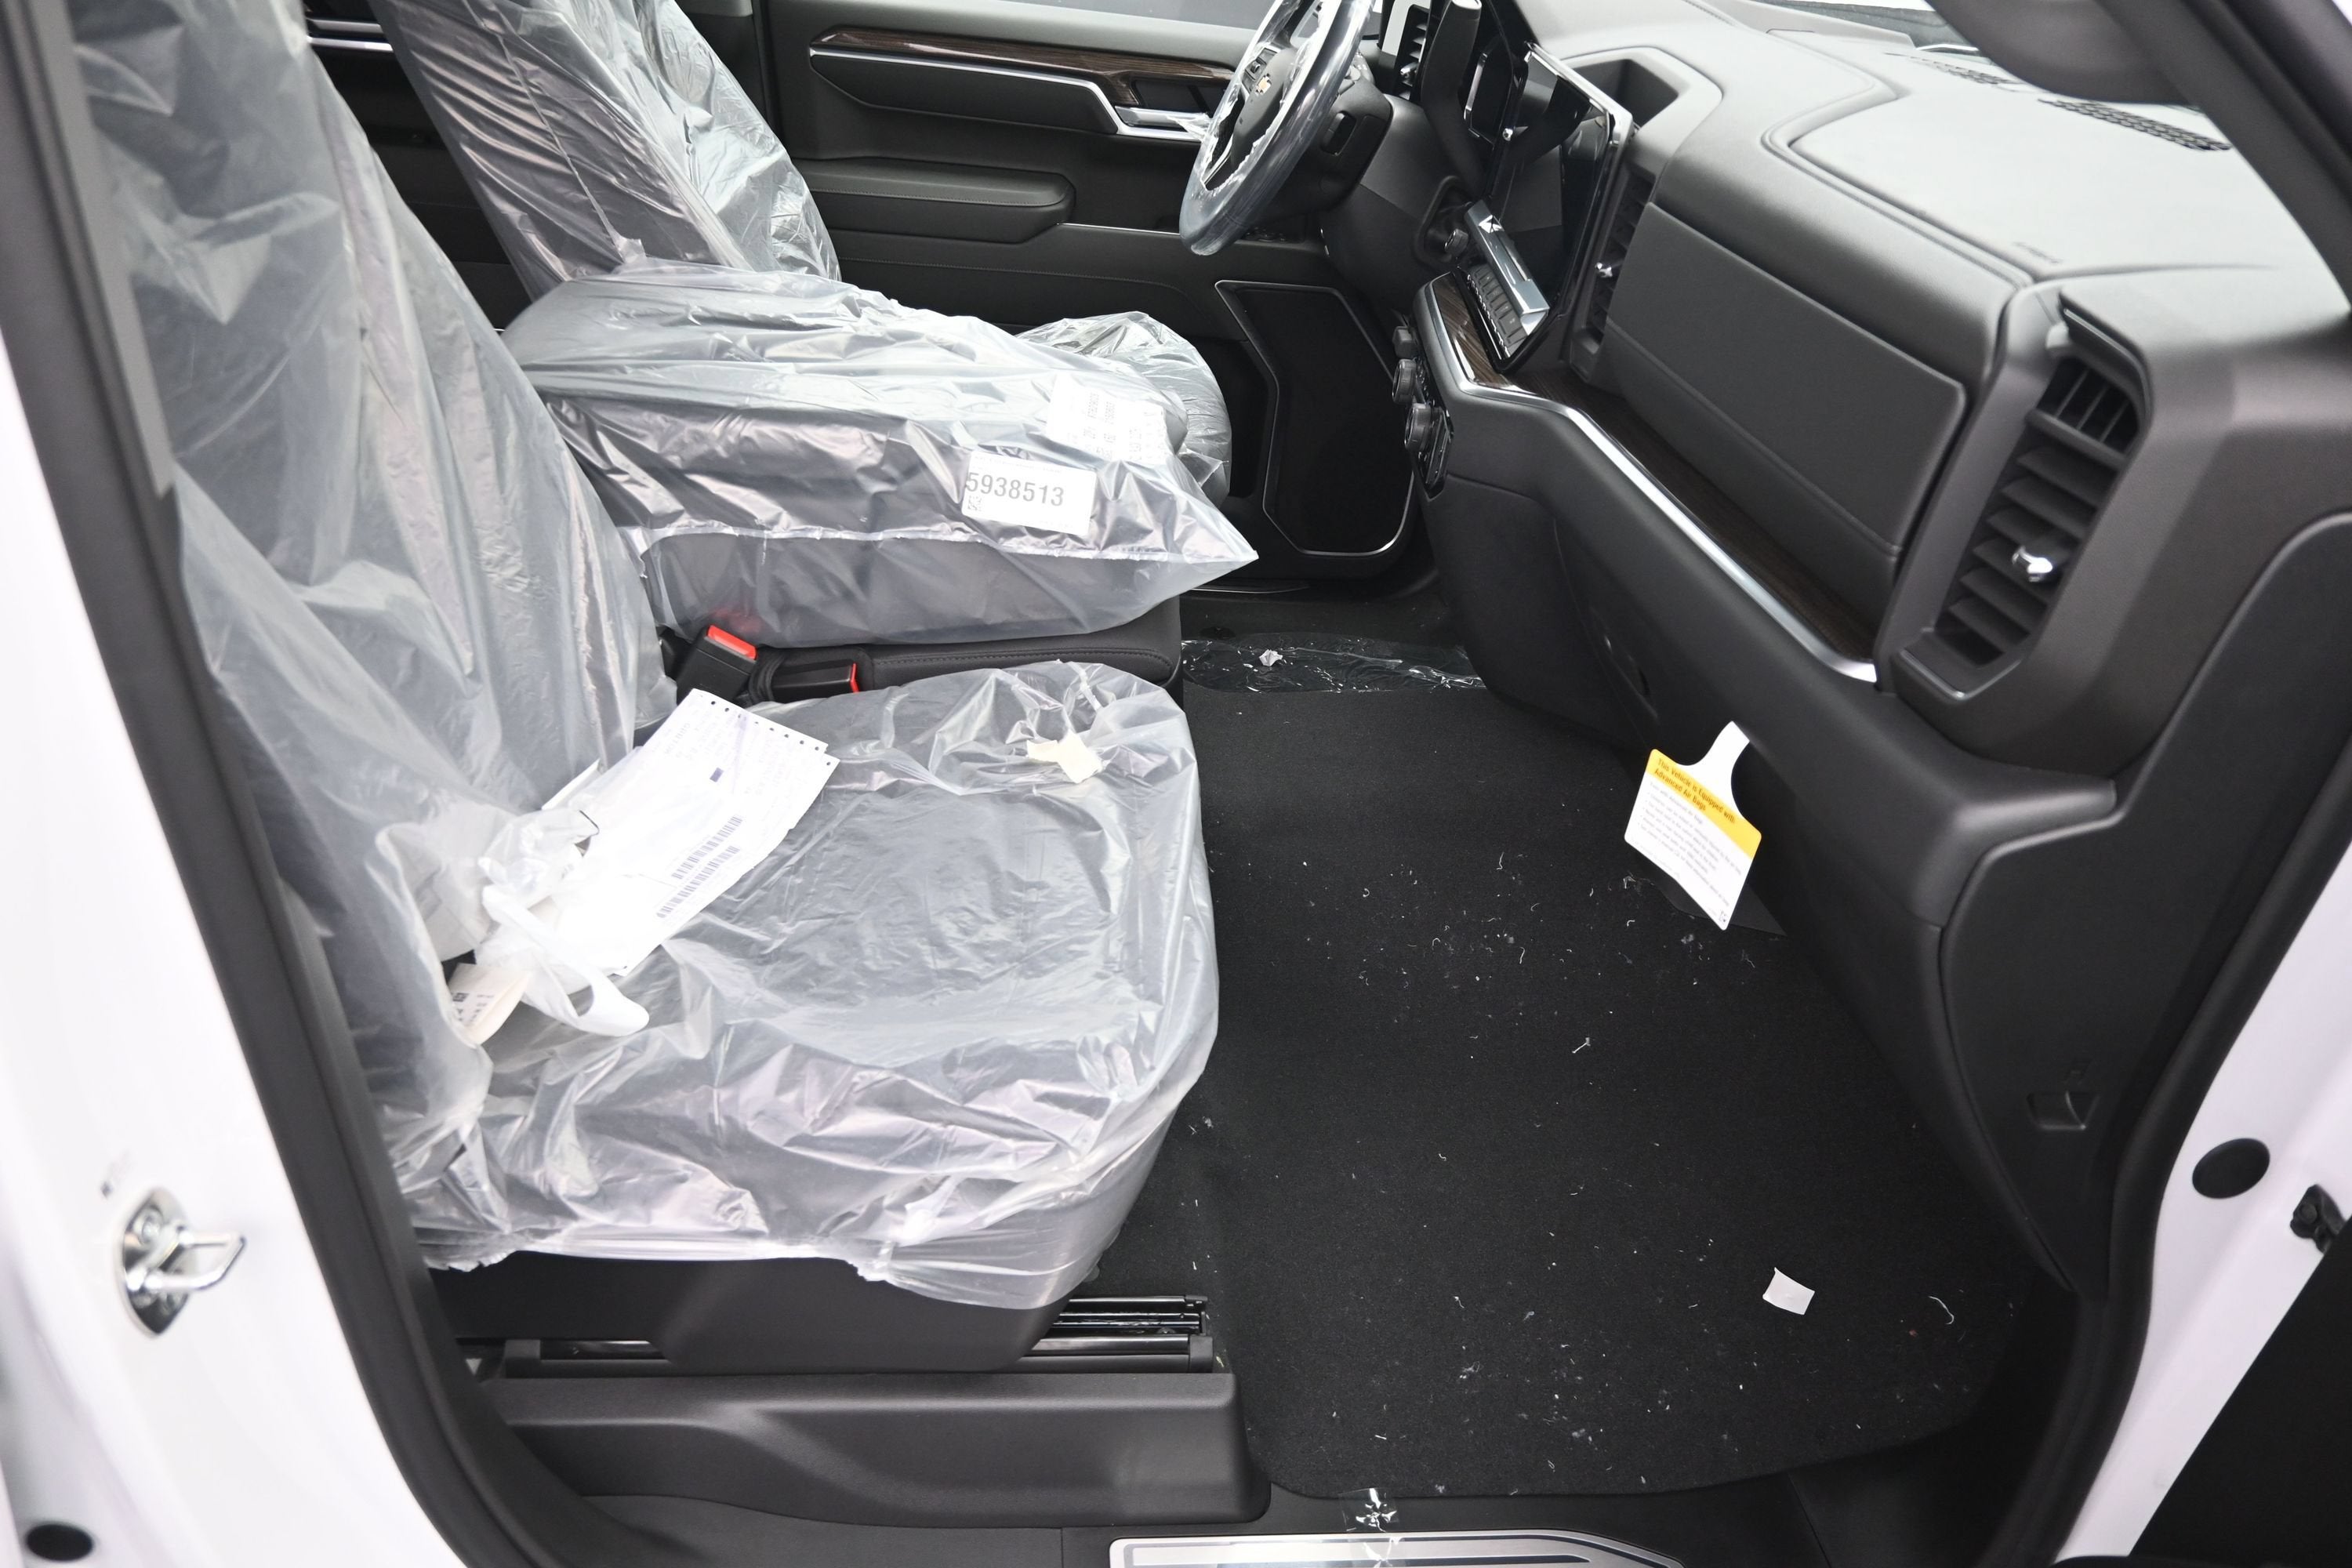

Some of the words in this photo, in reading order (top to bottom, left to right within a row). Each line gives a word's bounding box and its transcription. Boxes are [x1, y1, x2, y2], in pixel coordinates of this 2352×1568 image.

[966, 472, 1064, 506] 5938513
[1654, 768, 1682, 791] Advanced
[1683, 789, 1692, 798] Air
[1693, 795, 1705, 811] Bags
[1657, 758, 1669, 771] This
[1671, 768, 1691, 787] Vehicle
[1699, 788, 1724, 813] Equipped
[1724, 811, 1735, 824] with
